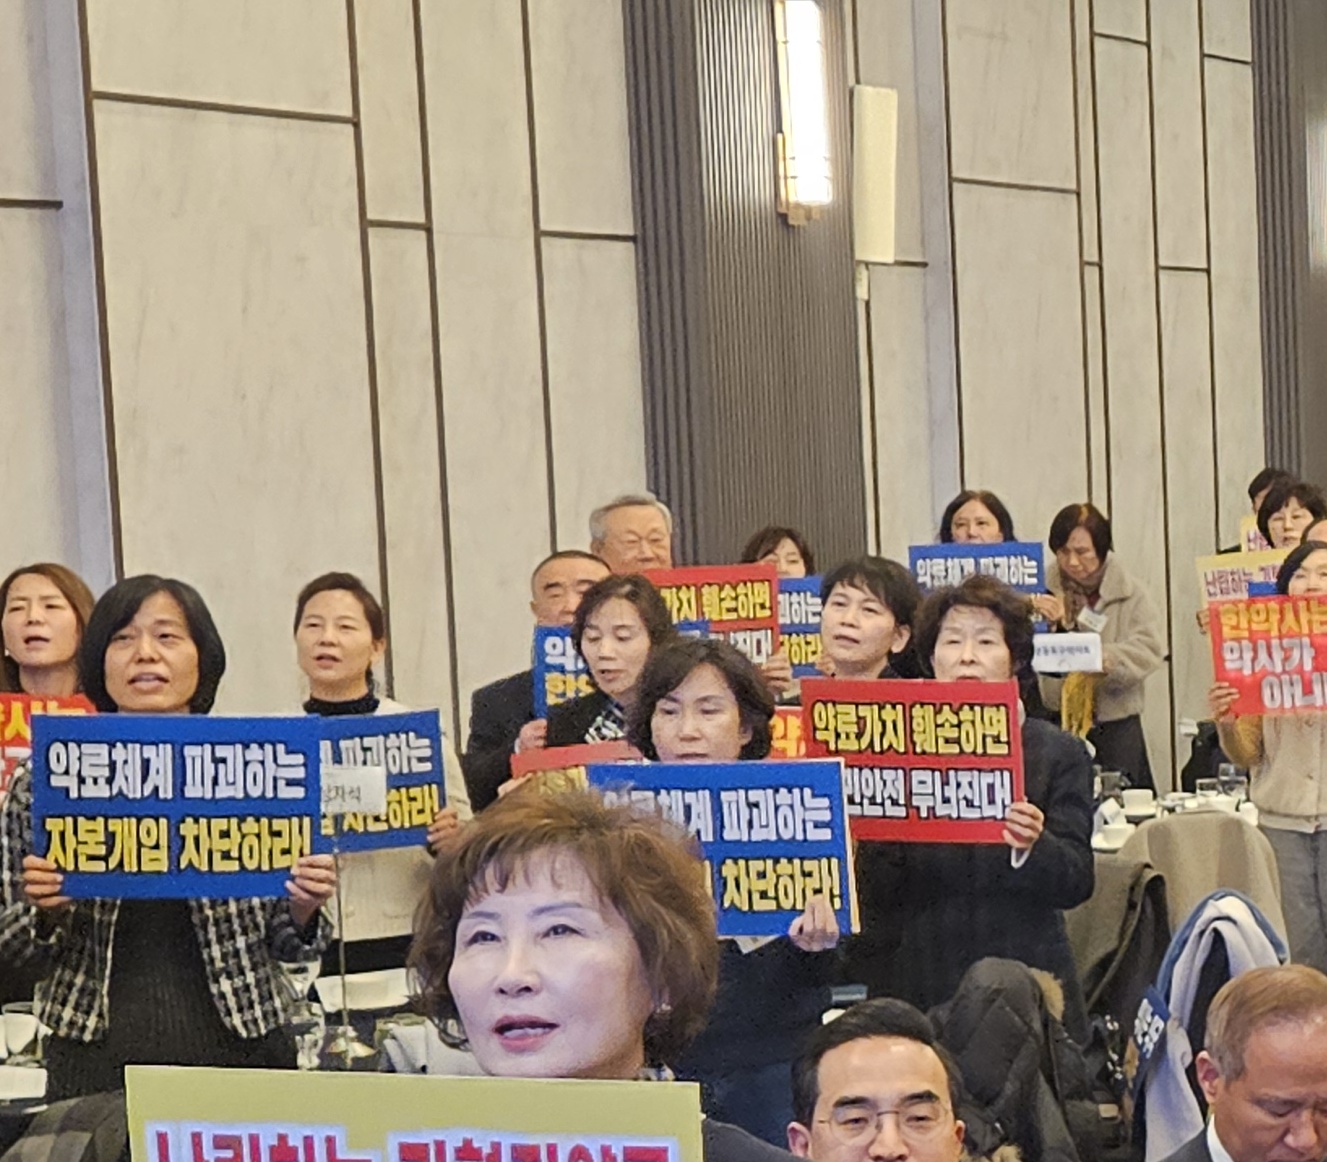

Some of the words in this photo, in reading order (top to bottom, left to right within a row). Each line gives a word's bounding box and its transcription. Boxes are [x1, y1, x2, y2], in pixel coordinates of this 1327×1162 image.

[1222, 636, 1316, 677] 약사가
[812, 702, 905, 754] 약료가치
[912, 703, 1010, 756] 훼손하면
[48, 741, 173, 801] 약료체계
[183, 743, 306, 800] 파괴하는
[845, 767, 907, 818] 민안전
[911, 768, 1012, 820] 무너진다!
[719, 788, 833, 843] 파괴하는
[44, 815, 169, 873] 자본개입
[179, 815, 311, 872] 차단하라!
[721, 857, 840, 912] 차단하라!
